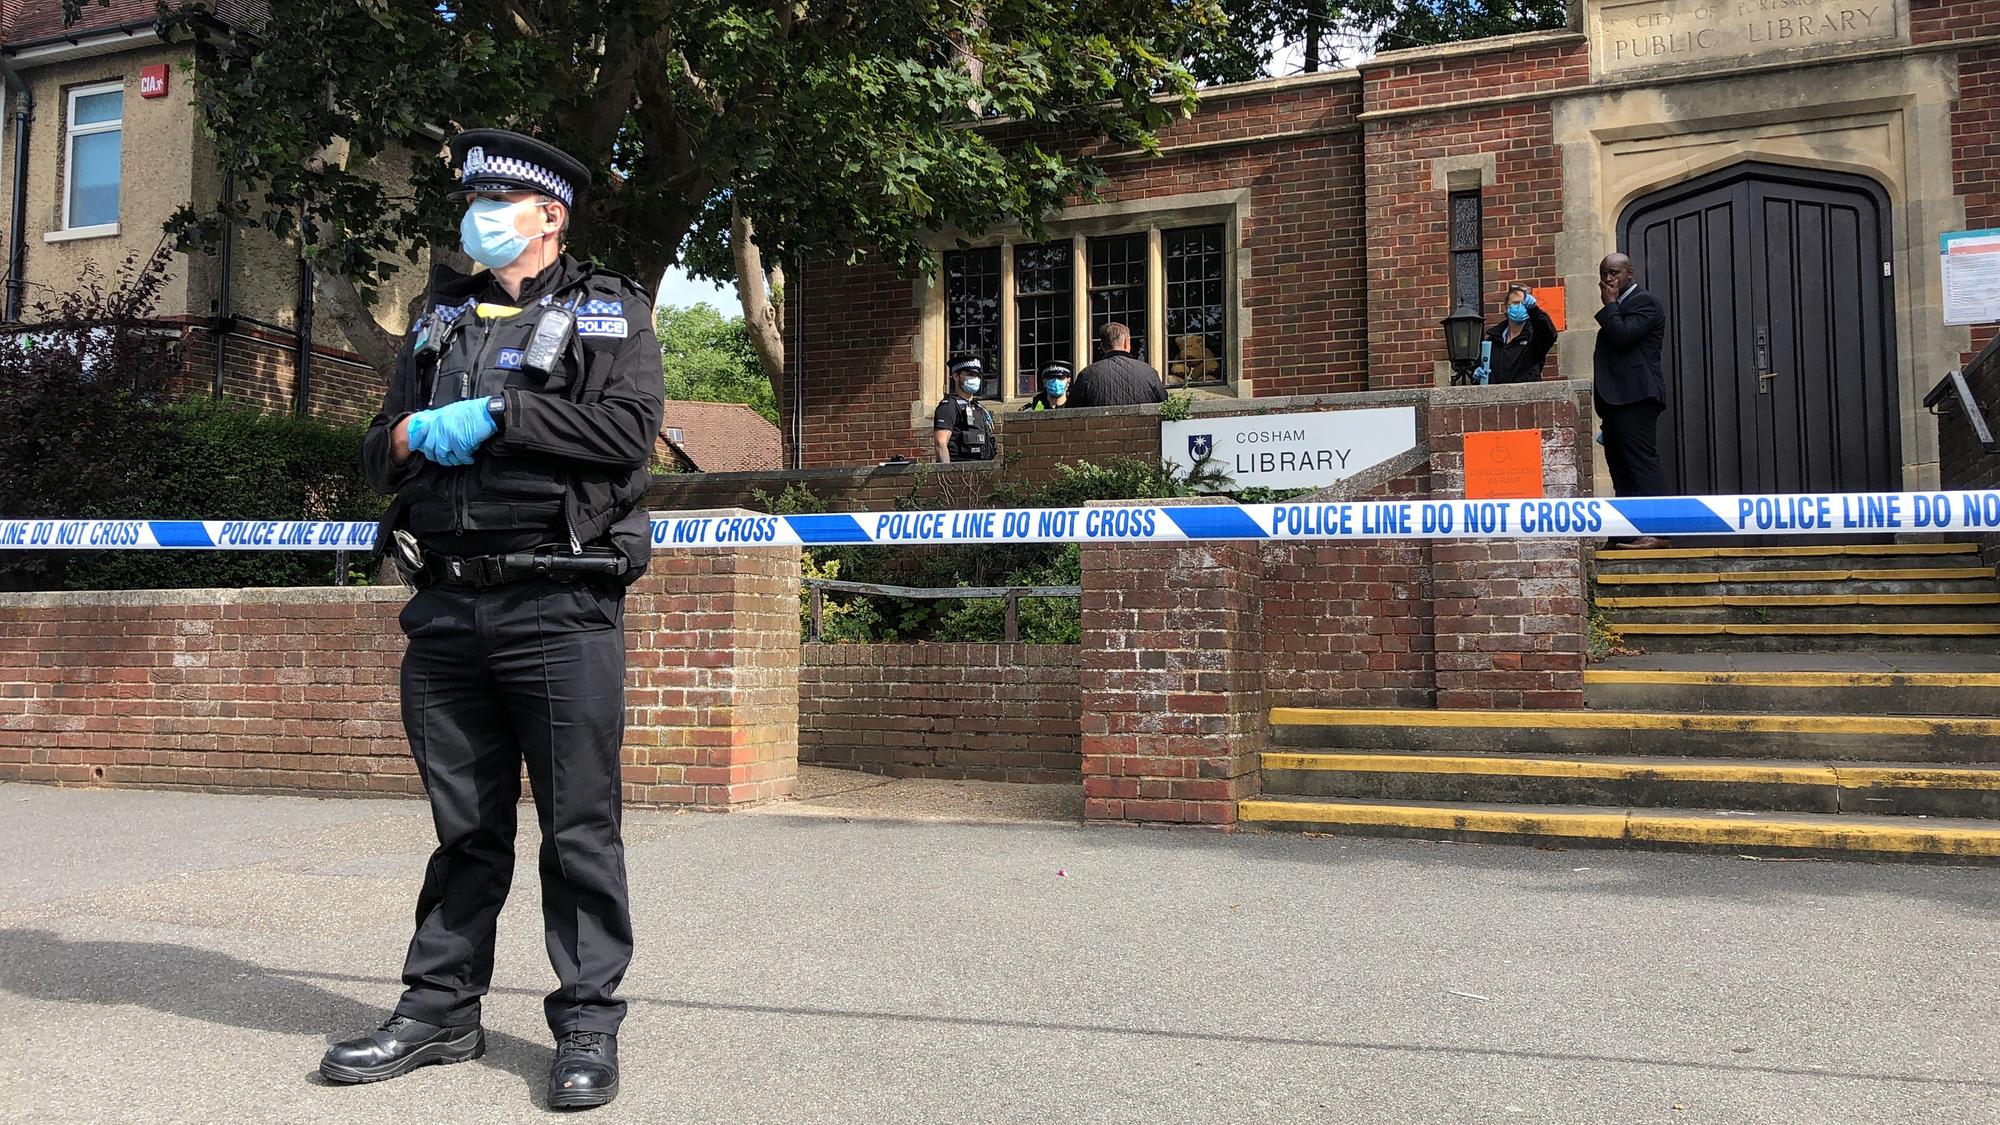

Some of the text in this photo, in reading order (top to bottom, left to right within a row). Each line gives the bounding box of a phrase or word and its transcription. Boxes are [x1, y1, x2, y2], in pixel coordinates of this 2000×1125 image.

[1636, 11, 1675, 28] CITY
[1695, 5, 1717, 20] OF
[1616, 6, 1878, 60] PUBLIC LIBRARY
[577, 320, 622, 334] POLICE
[1236, 430, 1305, 444] COSHAM
[1236, 449, 1351, 474] LIBRARY
[875, 509, 1156, 539] POLICE LINE DO NOT CROSS
[1272, 501, 1601, 535] POLICE LINE DO NOT CROSS
[1738, 493, 2000, 530] POLICE LINE DO NO
[0, 522, 143, 545] INE DO NOT CROSS
[217, 522, 279, 545] POLICE
[278, 522, 319, 545] LINE
[318, 522, 345, 545] DO
[672, 518, 712, 543] NOT
[714, 517, 778, 542] CROSS
